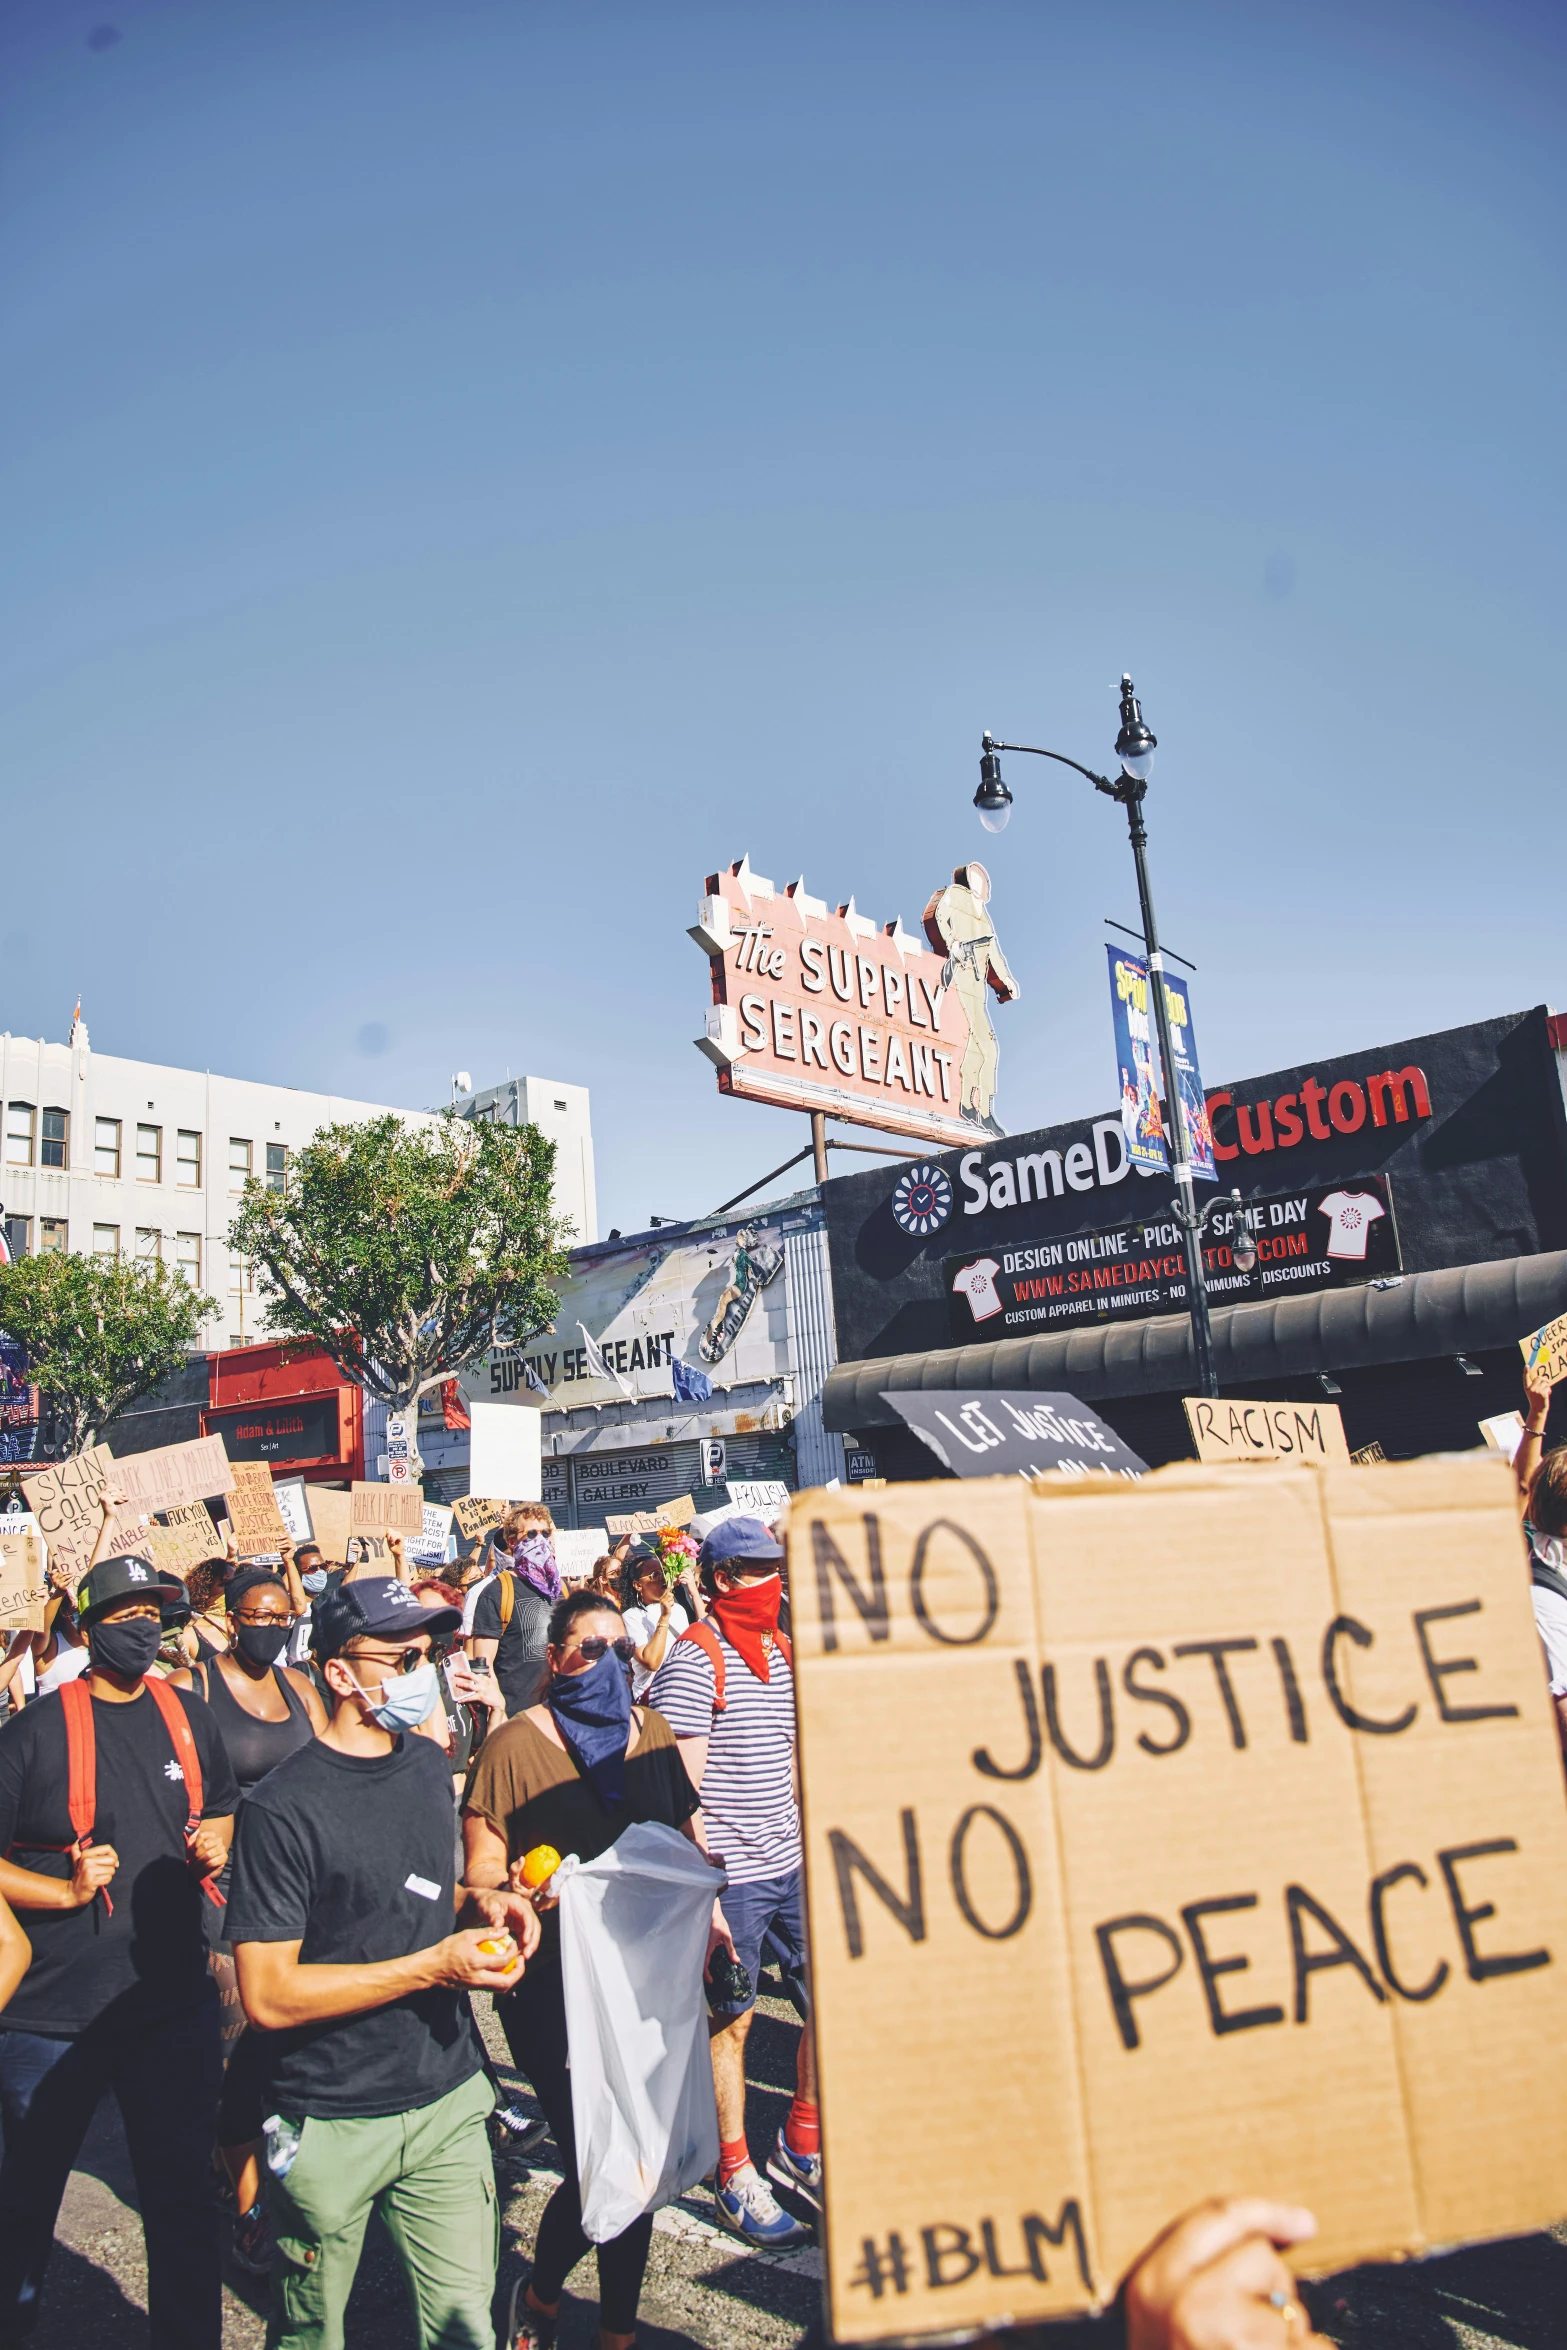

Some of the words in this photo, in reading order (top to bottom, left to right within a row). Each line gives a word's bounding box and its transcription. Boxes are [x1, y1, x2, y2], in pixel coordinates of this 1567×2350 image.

[732, 920, 787, 981] The
[799, 938, 948, 1032] SUPPLY
[739, 993, 953, 1103] SERGEANT
[959, 1119, 1174, 1216] SameD
[1206, 1064, 1433, 1161] Custom
[1003, 1242, 1063, 1274] DESIGN
[1066, 1232, 1128, 1263] ONLINE
[1270, 1198, 1309, 1227] DAY
[1004, 1308, 1047, 1325] CUSTOM
[1049, 1301, 1096, 1318] APPAREL
[1097, 1300, 1109, 1311] IN
[1111, 1289, 1160, 1309] MINUTES
[1170, 1285, 1187, 1299] NO
[1263, 1260, 1332, 1285] DISCOUNTS
[562, 1331, 675, 1383] SEGEANT
[235, 1424, 264, 1440] Adam
[265, 1420, 274, 1436] &
[275, 1416, 304, 1435] Lilith
[934, 1400, 1007, 1454] LET
[1000, 1398, 1117, 1453] JUSTICE
[1196, 1402, 1326, 1454] RACISM
[149, 1454, 183, 1493] LIVES
[181, 1442, 229, 1486] MATTER
[244, 1463, 259, 1471] WANT
[580, 1456, 669, 1478] BOULEVARD
[850, 1455, 875, 1469] ATM
[851, 1467, 875, 1475] INSIDE
[37, 1450, 105, 1502] SKIN
[249, 1484, 267, 1493] NEED
[228, 1493, 252, 1510] POLICE
[582, 1482, 649, 1502] GALLERY
[734, 1484, 793, 1510] ABOLISH
[166, 1505, 191, 1527] FUCK
[187, 1503, 207, 1520] YOU
[240, 1512, 274, 1529] JUSTICE
[249, 1505, 275, 1514] DEMAND
[353, 1492, 376, 1523] BLACK
[378, 1492, 399, 1525] LIVES
[400, 1493, 423, 1526] MATTER
[423, 1508, 438, 1519] THE
[69, 1513, 92, 1532] IS
[423, 1527, 446, 1539] ACIST
[607, 1518, 638, 1533] BLACK
[638, 1514, 672, 1531] LIVES
[238, 1538, 257, 1554] BLACK
[404, 1535, 425, 1547] IGHT
[426, 1539, 443, 1550] FOR
[808, 1511, 1000, 1655] NO
[971, 1599, 1521, 1783] JUSTICE
[825, 1802, 1034, 1961] NO
[1093, 1836, 1554, 2052] PEACE
[848, 2196, 1096, 2300] #BLM
